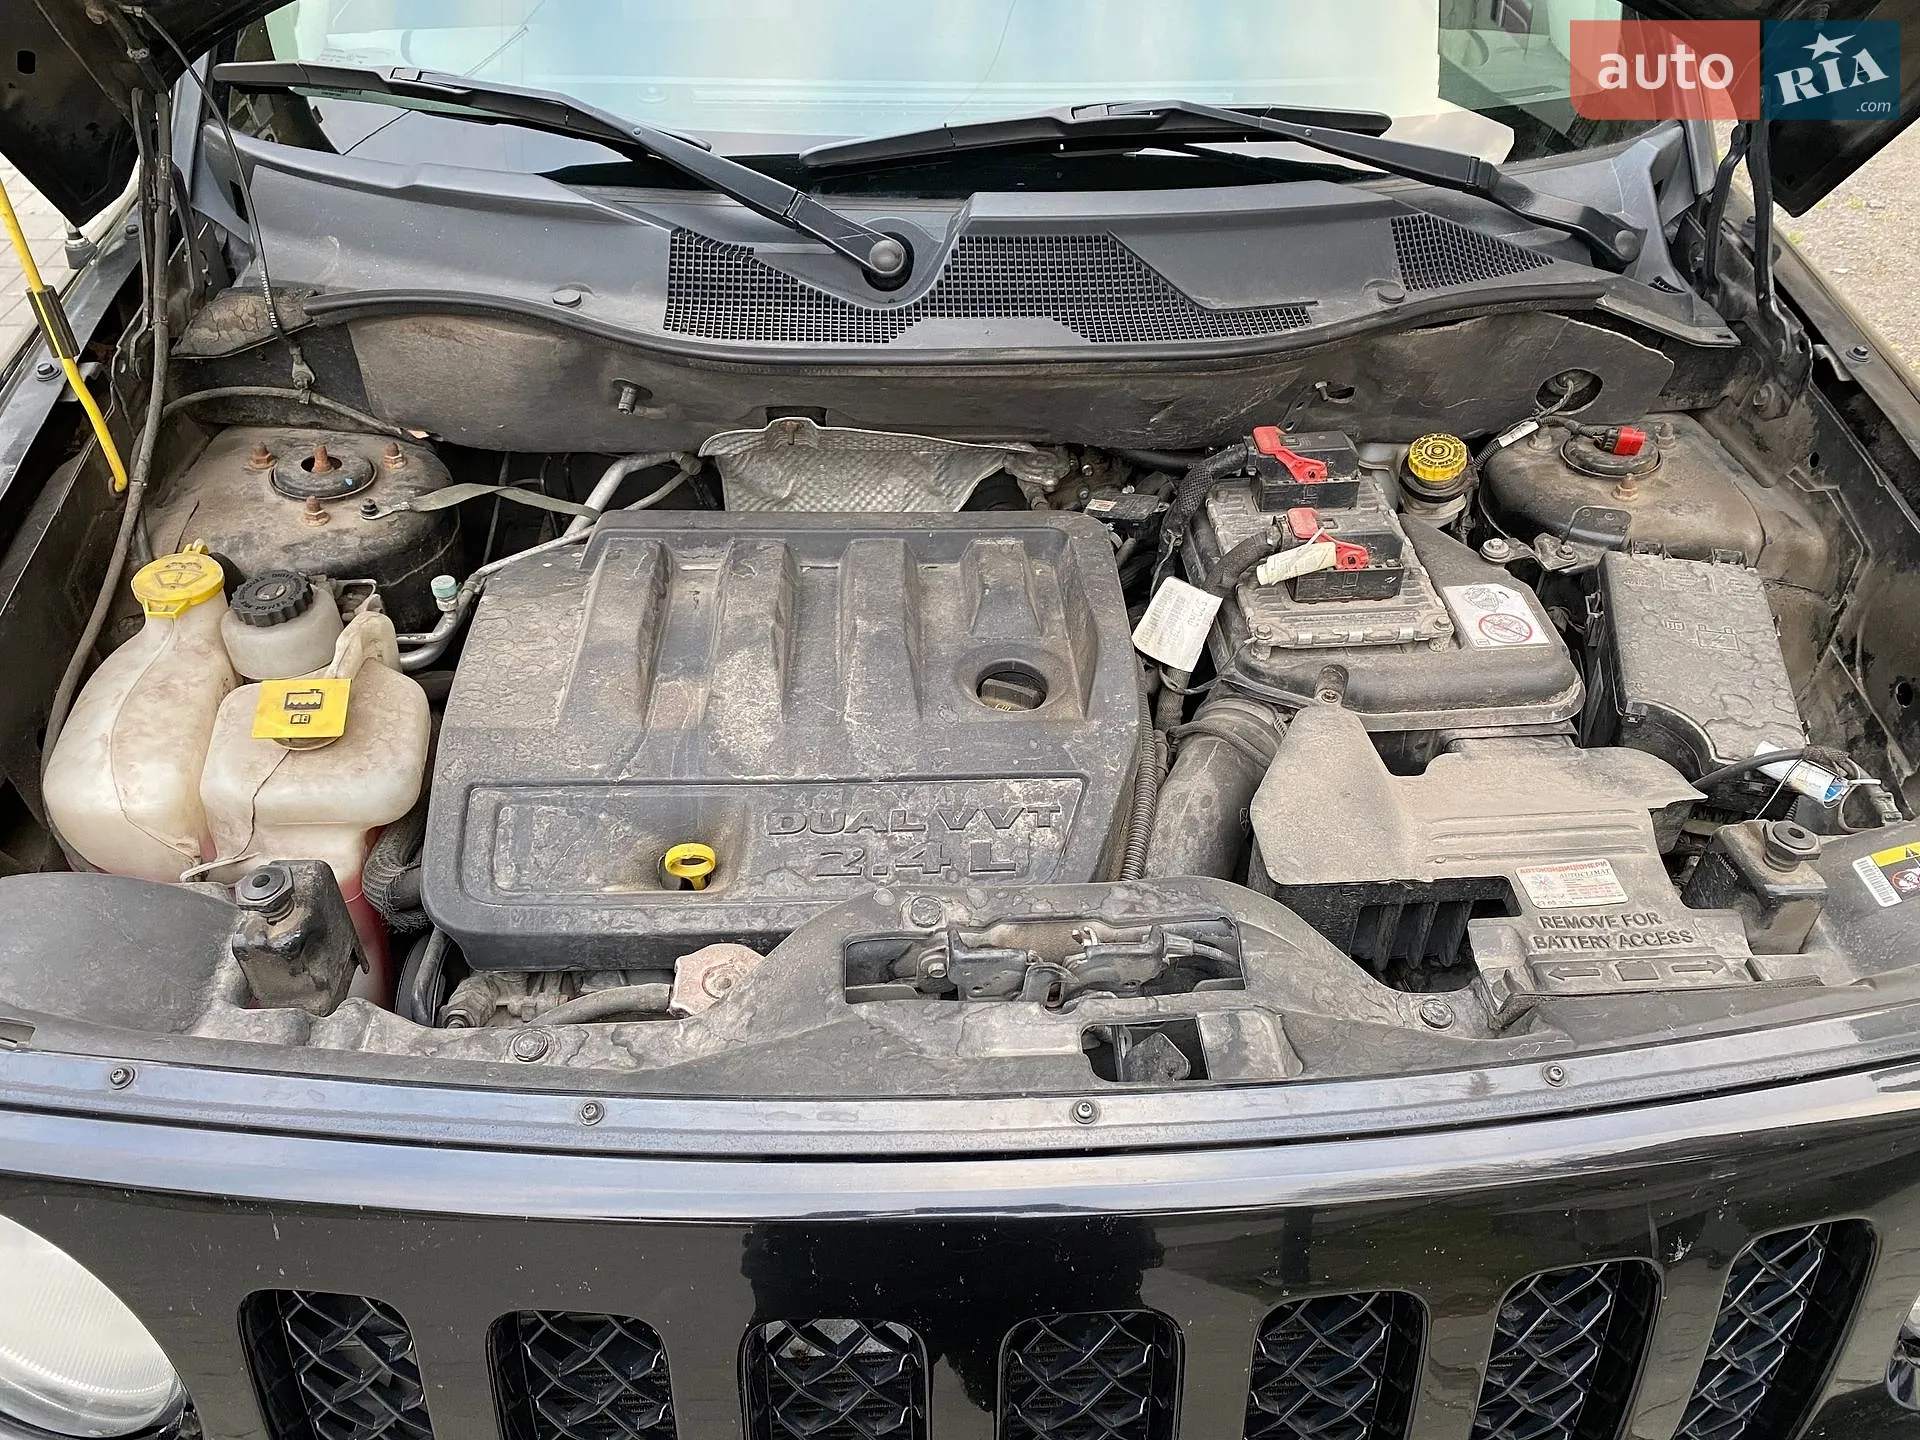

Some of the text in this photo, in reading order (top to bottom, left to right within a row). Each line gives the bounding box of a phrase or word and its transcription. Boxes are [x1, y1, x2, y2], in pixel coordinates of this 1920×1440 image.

[764, 803, 1061, 835] DUAL VVT
[1538, 912, 1662, 930] REMOVE FOR
[1533, 929, 1694, 950] BATTERY ACCESS
